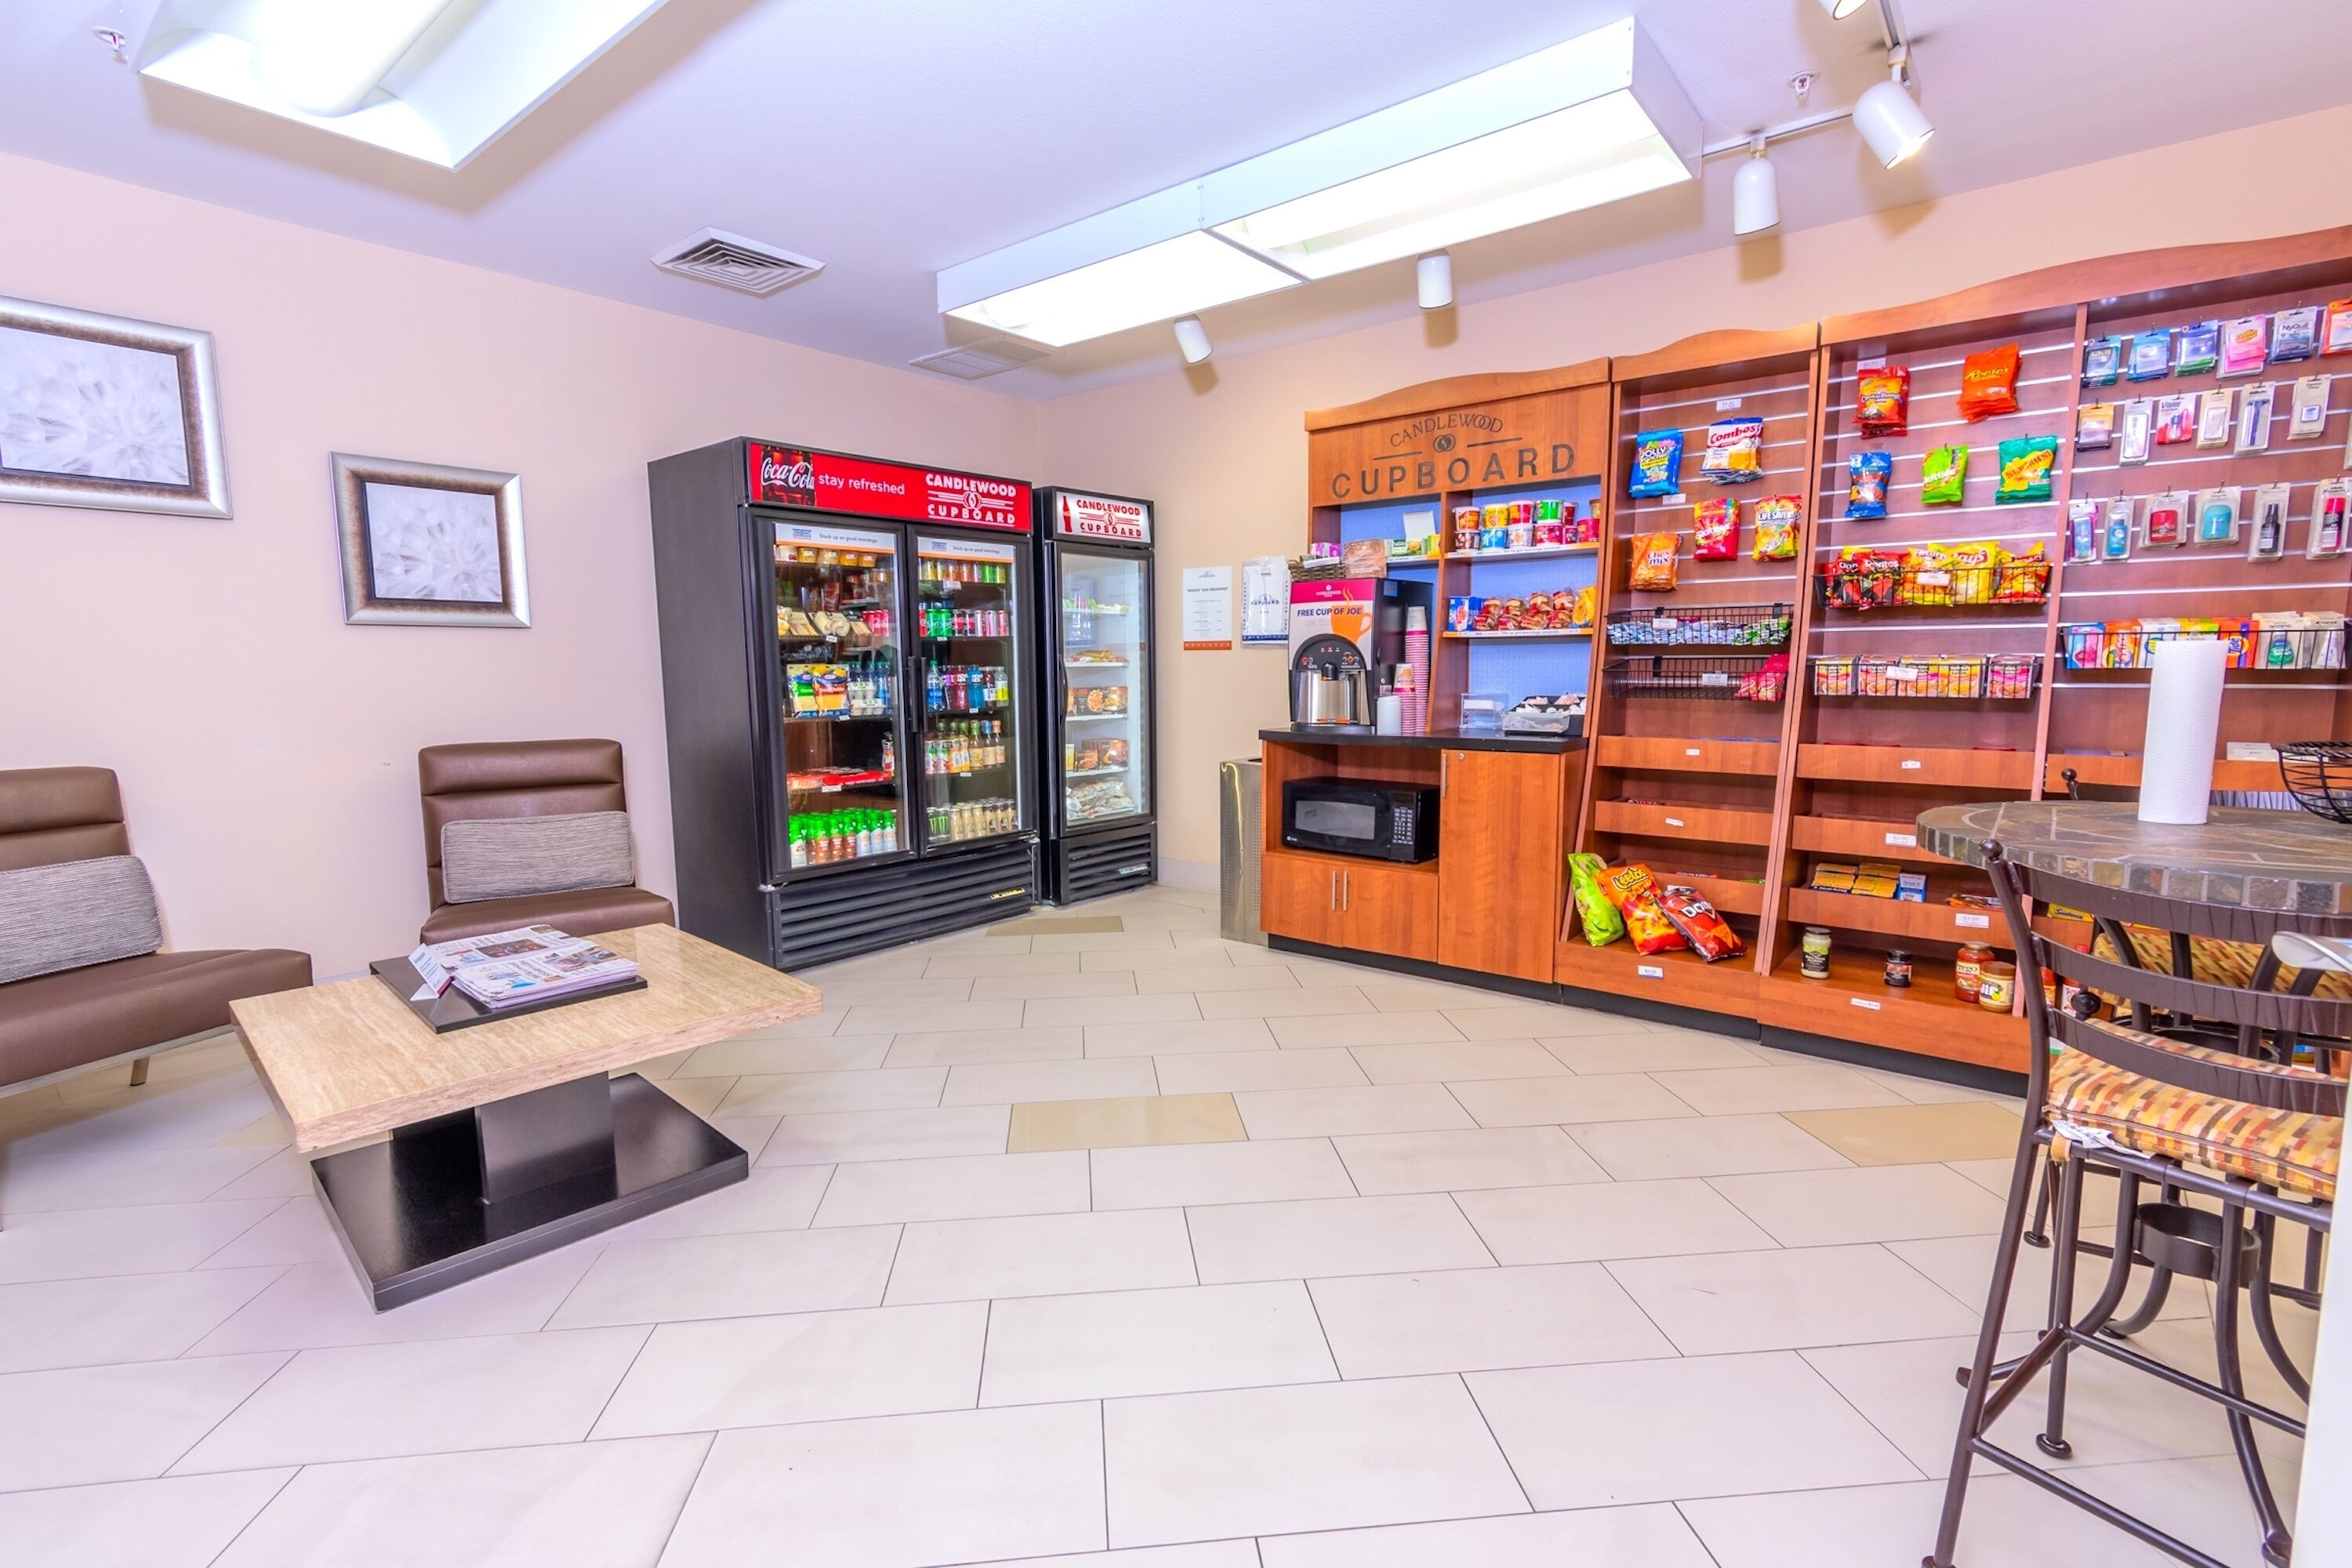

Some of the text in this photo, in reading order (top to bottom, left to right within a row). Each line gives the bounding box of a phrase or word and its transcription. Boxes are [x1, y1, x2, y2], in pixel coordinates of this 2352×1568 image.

[2282, 322, 2309, 332] NyQuil
[1390, 413, 1503, 447] CANDLEWOOD
[1710, 425, 1757, 445] Combos
[1640, 446, 1667, 459] JOLLY
[760, 457, 815, 491] Coca-Cola
[1331, 443, 1575, 499] CUPBOARD
[818, 474, 906, 495] stay refreshed
[925, 473, 1017, 498] CANDLEWOOD
[927, 503, 1016, 525] CUPBOARD
[1076, 499, 1141, 516] CANDLEWOOD
[1080, 522, 1142, 537] CUPBOARD
[1864, 559, 1900, 568] Doritos
[1297, 608, 1315, 617] FREE
[1612, 867, 1650, 891] Ceetos
